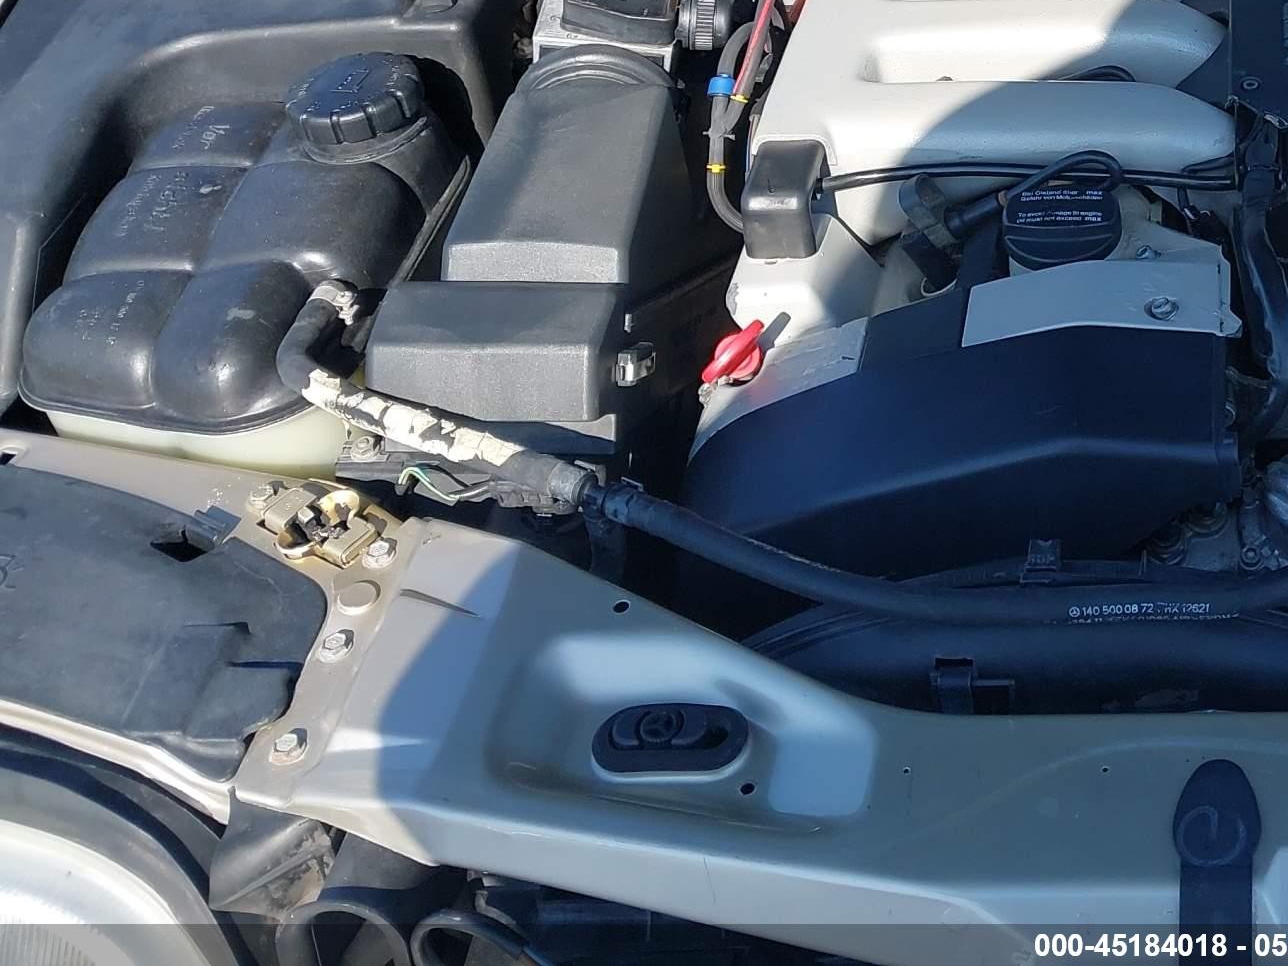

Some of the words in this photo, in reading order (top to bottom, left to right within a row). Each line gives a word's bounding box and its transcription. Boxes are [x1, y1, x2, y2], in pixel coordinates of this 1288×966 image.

[1082, 606, 1100, 616] 140
[1102, 605, 1123, 615] 500
[1123, 604, 1139, 614] 08
[1141, 603, 1154, 614] 72
